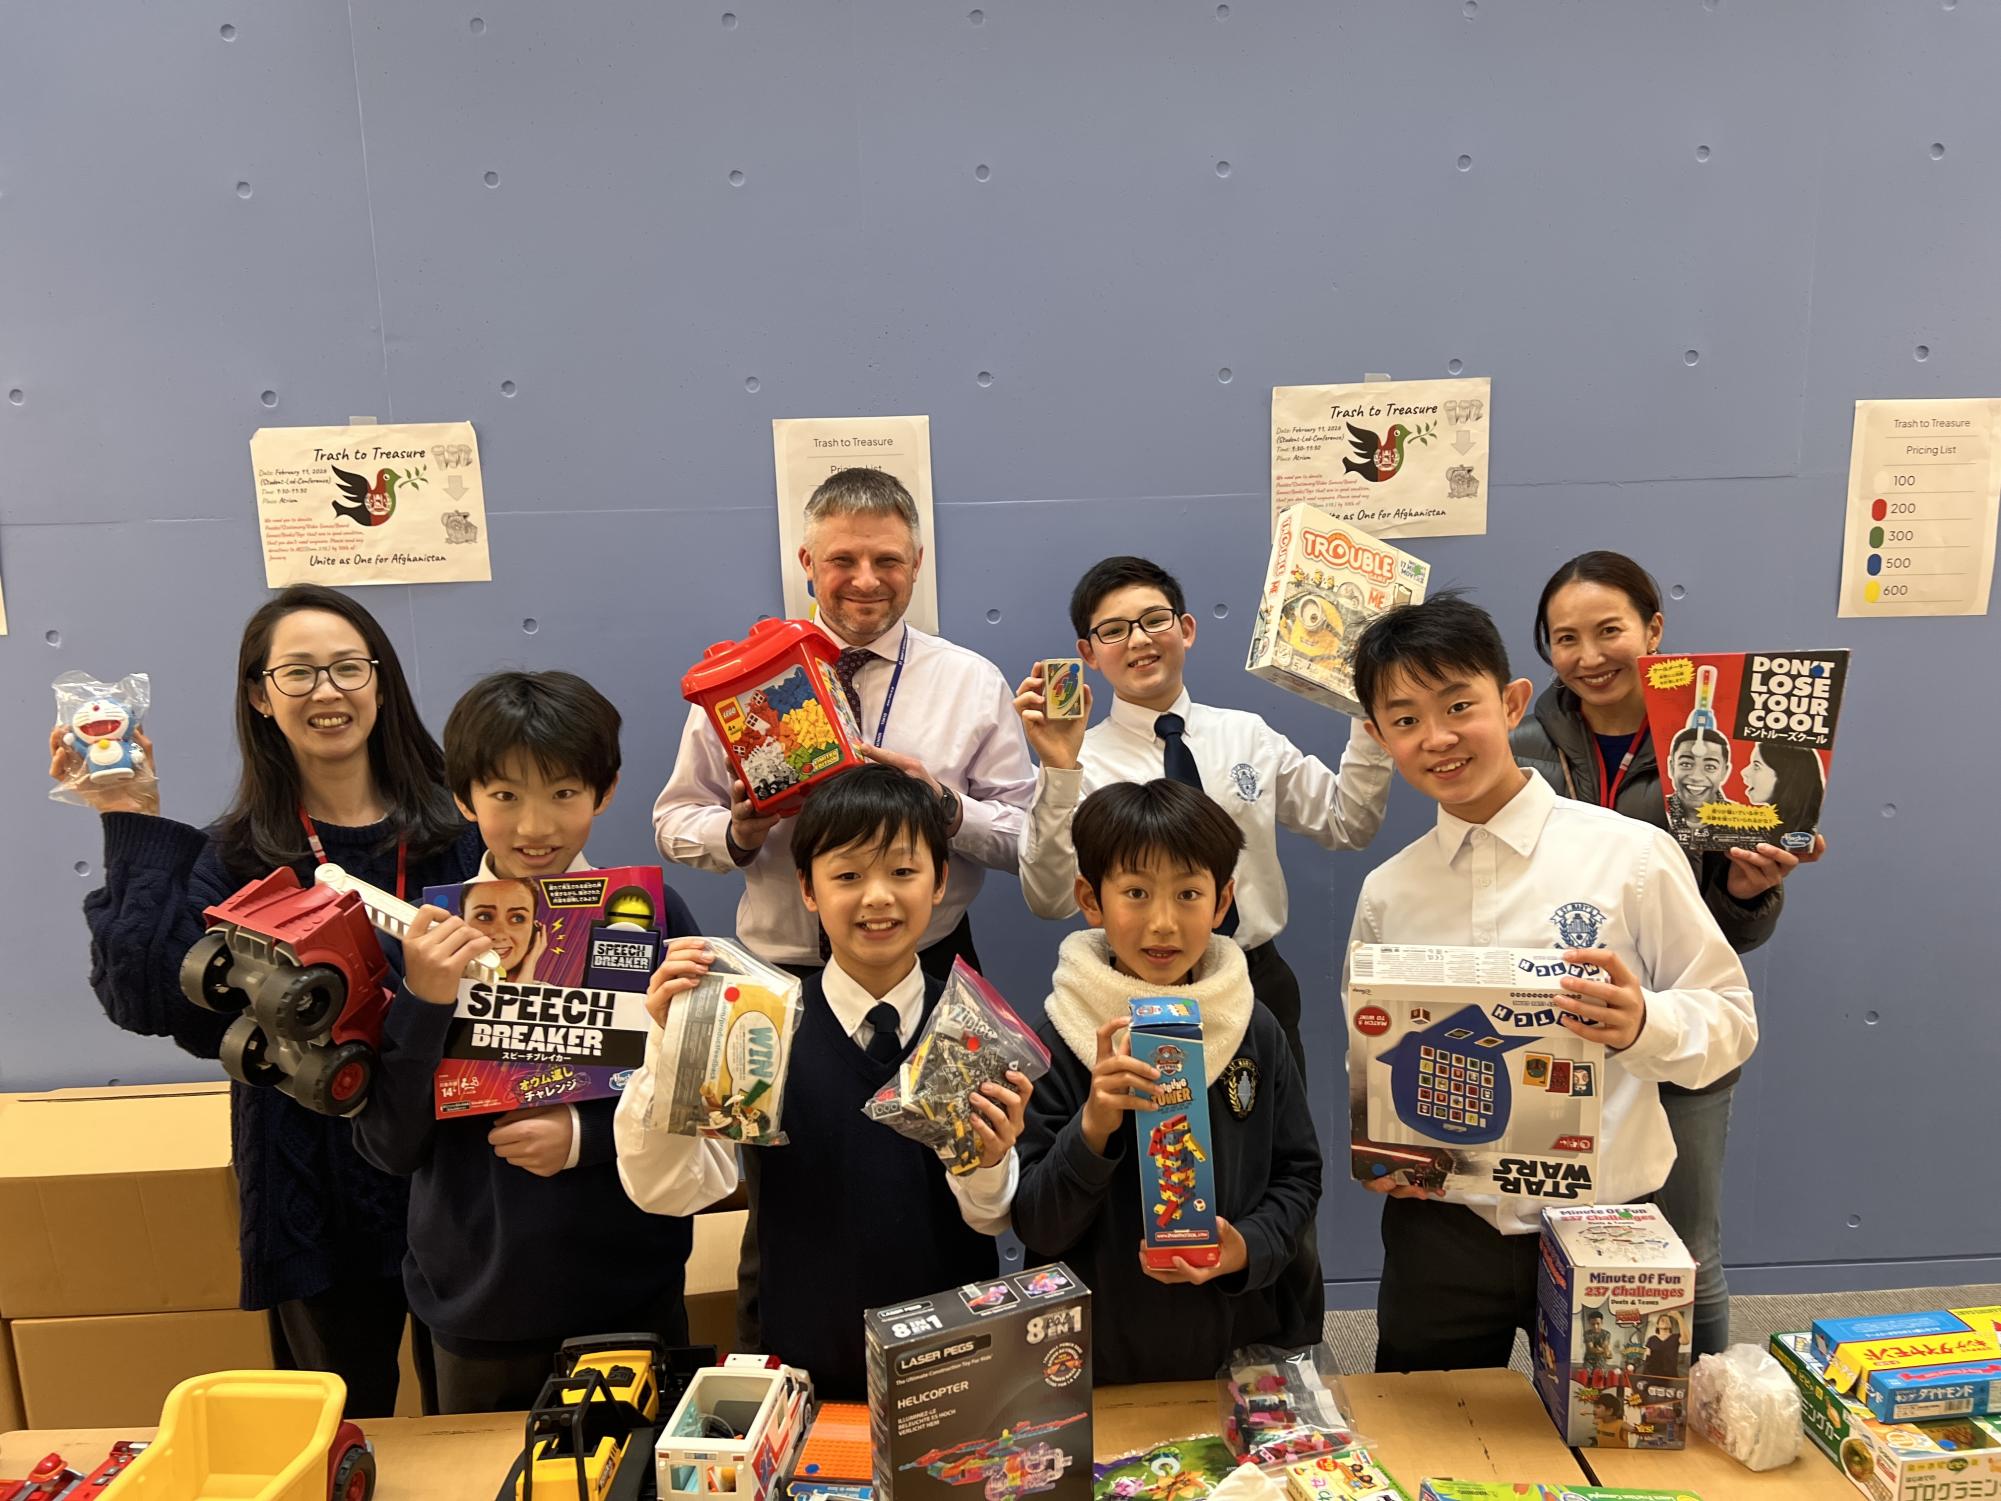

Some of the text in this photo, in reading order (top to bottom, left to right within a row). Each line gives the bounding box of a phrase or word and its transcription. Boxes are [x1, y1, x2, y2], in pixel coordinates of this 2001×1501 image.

[1330, 403, 1438, 419] Trash to Treasure
[1292, 426, 1316, 434] February
[1894, 419, 1971, 428] Trash to Treasure
[813, 436, 893, 448] Trash to Treasure
[313, 446, 426, 462] Trash to Treasure
[1906, 445, 1957, 456] Pricing List
[1893, 475, 1916, 486] 100
[1343, 511, 1354, 521] as
[1357, 508, 1376, 521] One
[1378, 507, 1391, 520] for
[1394, 507, 1446, 521] Afghanistan
[1890, 503, 1916, 514] 200
[1888, 530, 1914, 541] 300
[309, 553, 448, 567] Unite as One for Afghanistan
[1303, 531, 1395, 579] TROUBLE
[1886, 558, 1911, 569] 500
[1883, 585, 1908, 596] 600
[1750, 673, 1831, 698] LOSE
[1750, 692, 1830, 717] YOUR
[1747, 709, 1830, 735] COOL
[1743, 725, 1828, 745] ドントルーズクール
[596, 942, 646, 957] SPEECH
[594, 955, 650, 970] BREAKER
[467, 982, 616, 1027] SPEECH
[1364, 1019, 1388, 1027] MATCH
[471, 1023, 604, 1056] BREAKER
[501, 1050, 572, 1062] スピーチブレイカー
[747, 1027, 774, 1079] WIN
[518, 1065, 574, 1091] オウム返し
[524, 1079, 578, 1102] チャレンジ
[1492, 1158, 1592, 1183] WARS
[1492, 1173, 1592, 1199] STAR
[1560, 1208, 1604, 1216] Minute
[1589, 1272, 1681, 1284] Minute Of Fun
[1584, 1285, 1685, 1300] 237 Challenges
[891, 1322, 912, 1338] 8
[926, 1314, 943, 1329] 1
[1026, 1305, 1082, 1345] 8 1
[1047, 1323, 1069, 1337] EN
[901, 1341, 975, 1369] LASER PEGS
[906, 1373, 929, 1383] Ultimate
[929, 1364, 961, 1377] Construction
[961, 1360, 971, 1368] Toy
[897, 1380, 969, 1410] HELICOPTER
[898, 1417, 931, 1430] BELEUCHTE
[938, 1409, 956, 1418] HOCH
[898, 1424, 926, 1436] VERLICHT
